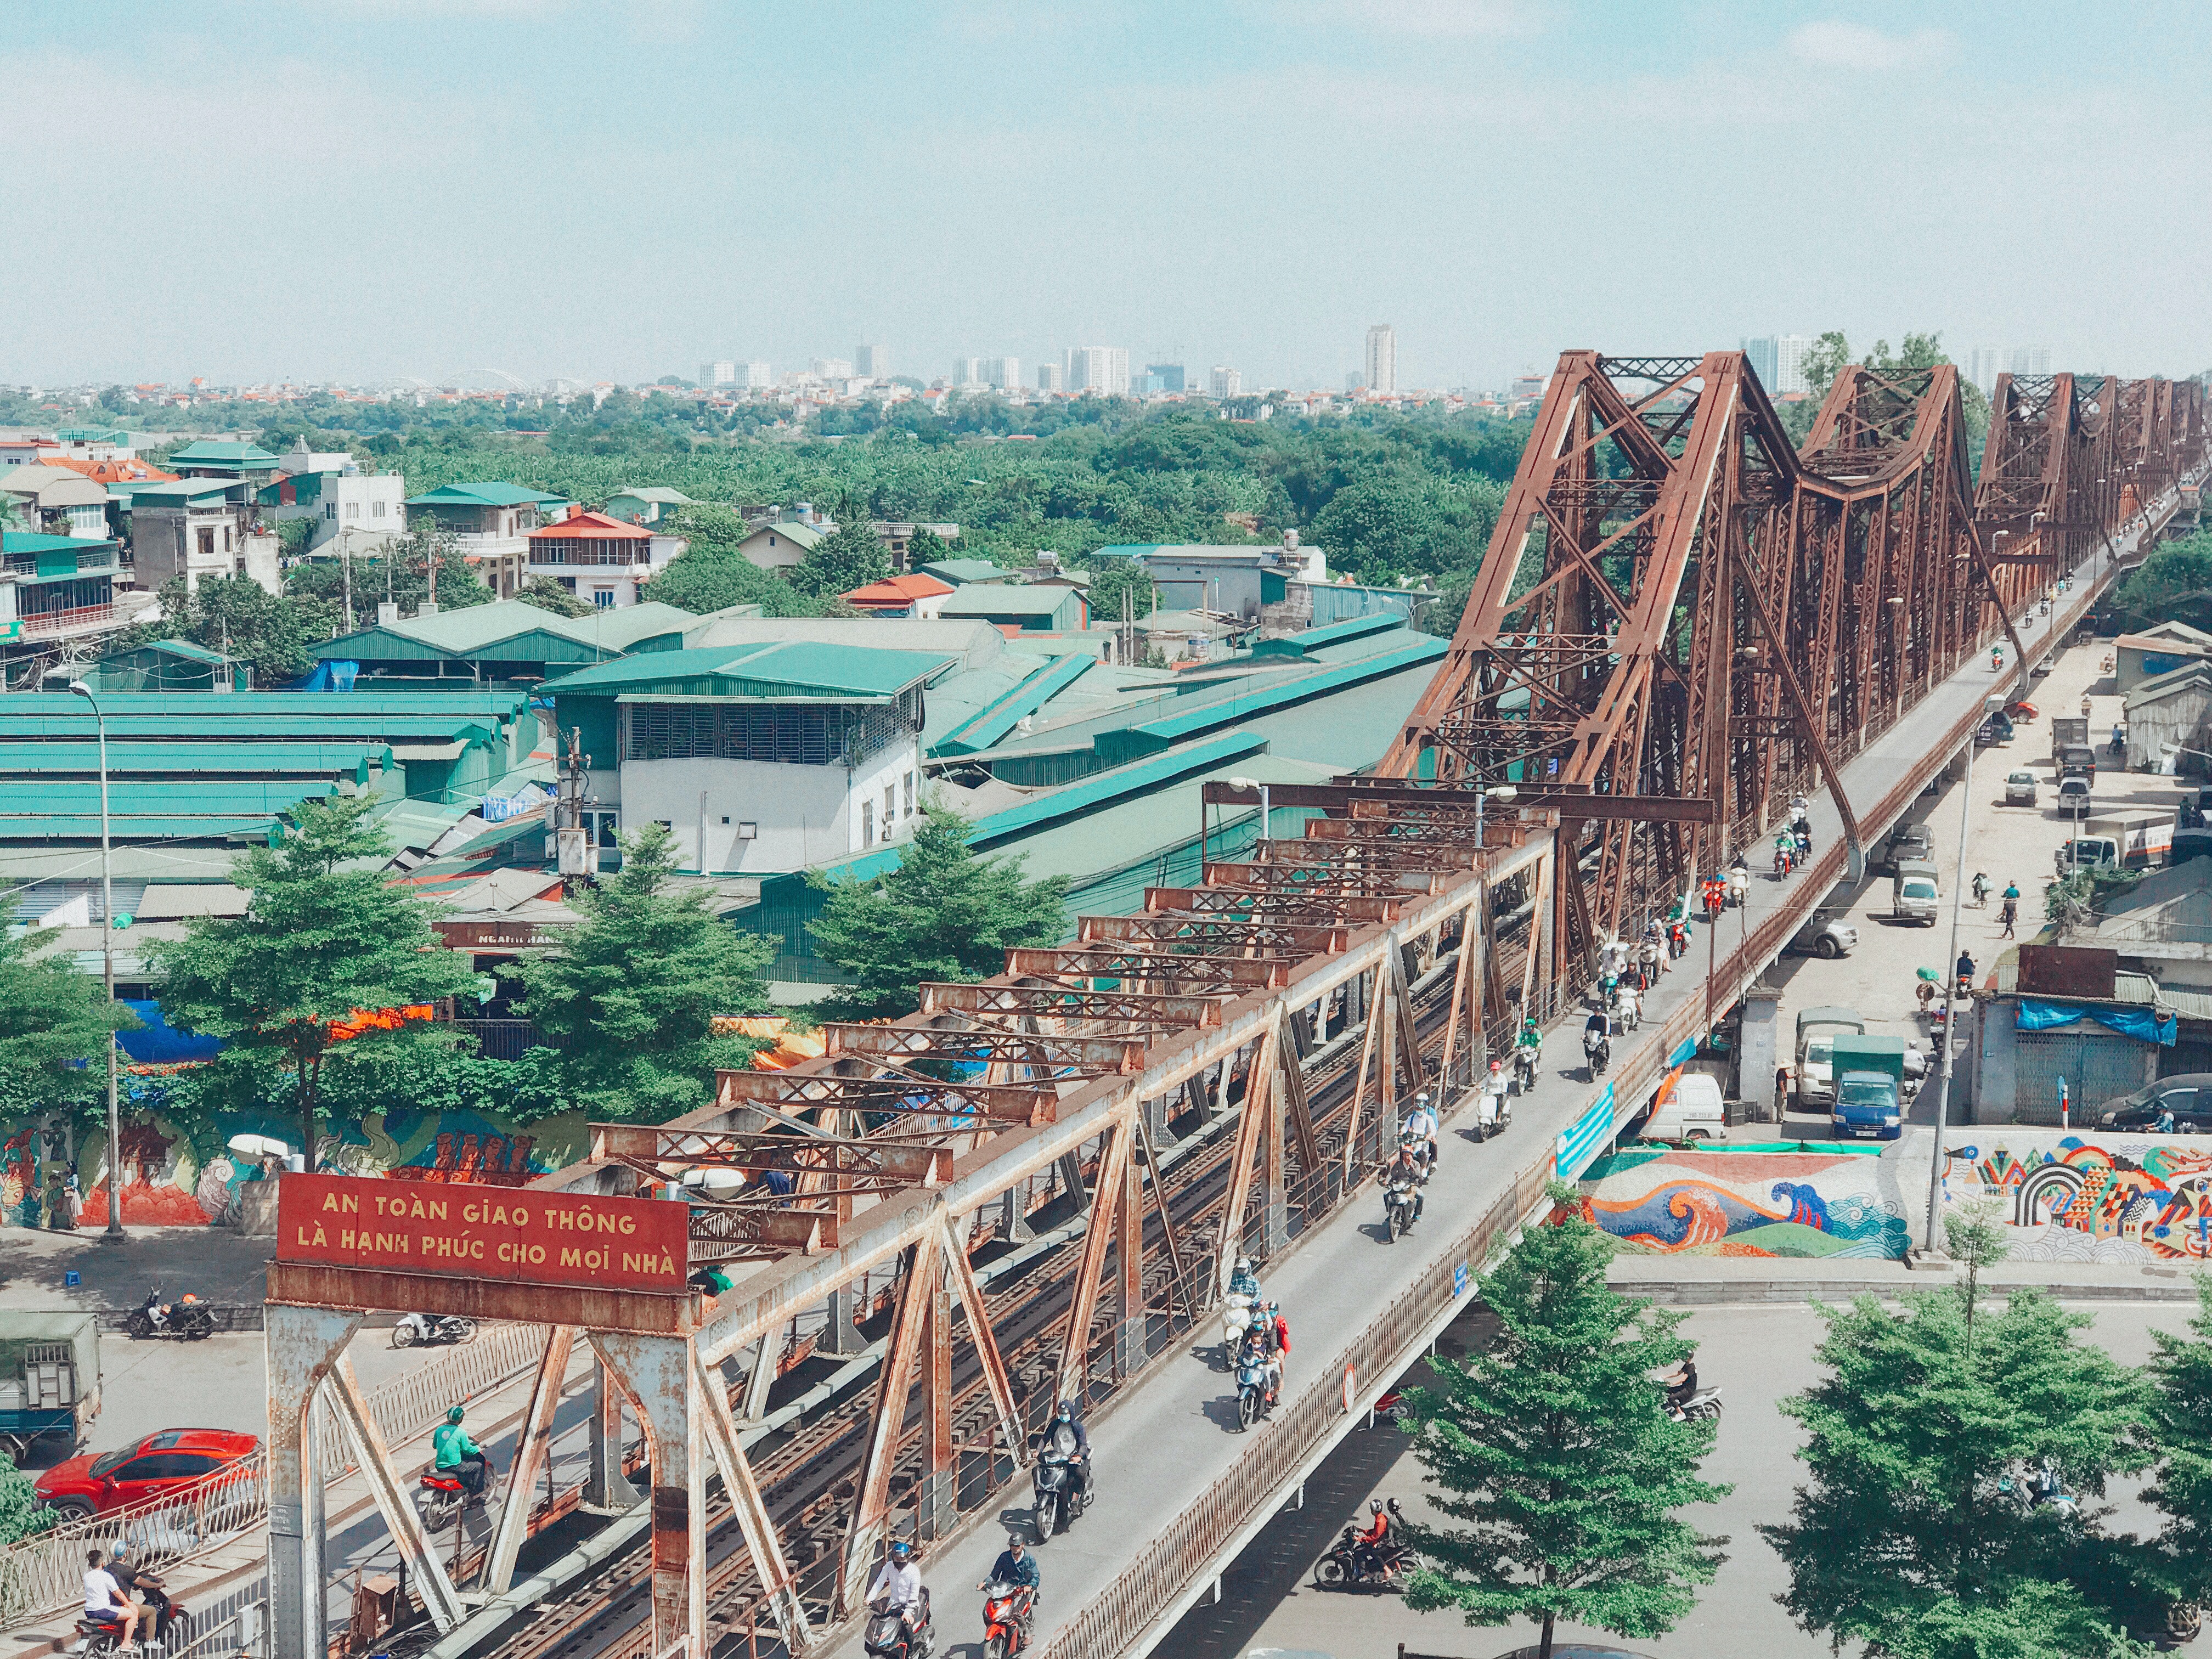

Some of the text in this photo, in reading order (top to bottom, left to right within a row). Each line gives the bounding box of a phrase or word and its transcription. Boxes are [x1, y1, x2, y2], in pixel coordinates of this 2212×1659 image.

[322, 1193, 359, 1214] AN
[375, 1192, 447, 1221] TOÀN
[544, 1204, 636, 1234] THÔNG
[297, 1219, 328, 1248] LÀ
[341, 1229, 409, 1256] HẠNH
[421, 1229, 484, 1260] PHÚC
[497, 1240, 546, 1264] CHO
[622, 1244, 676, 1276] NHÀ
